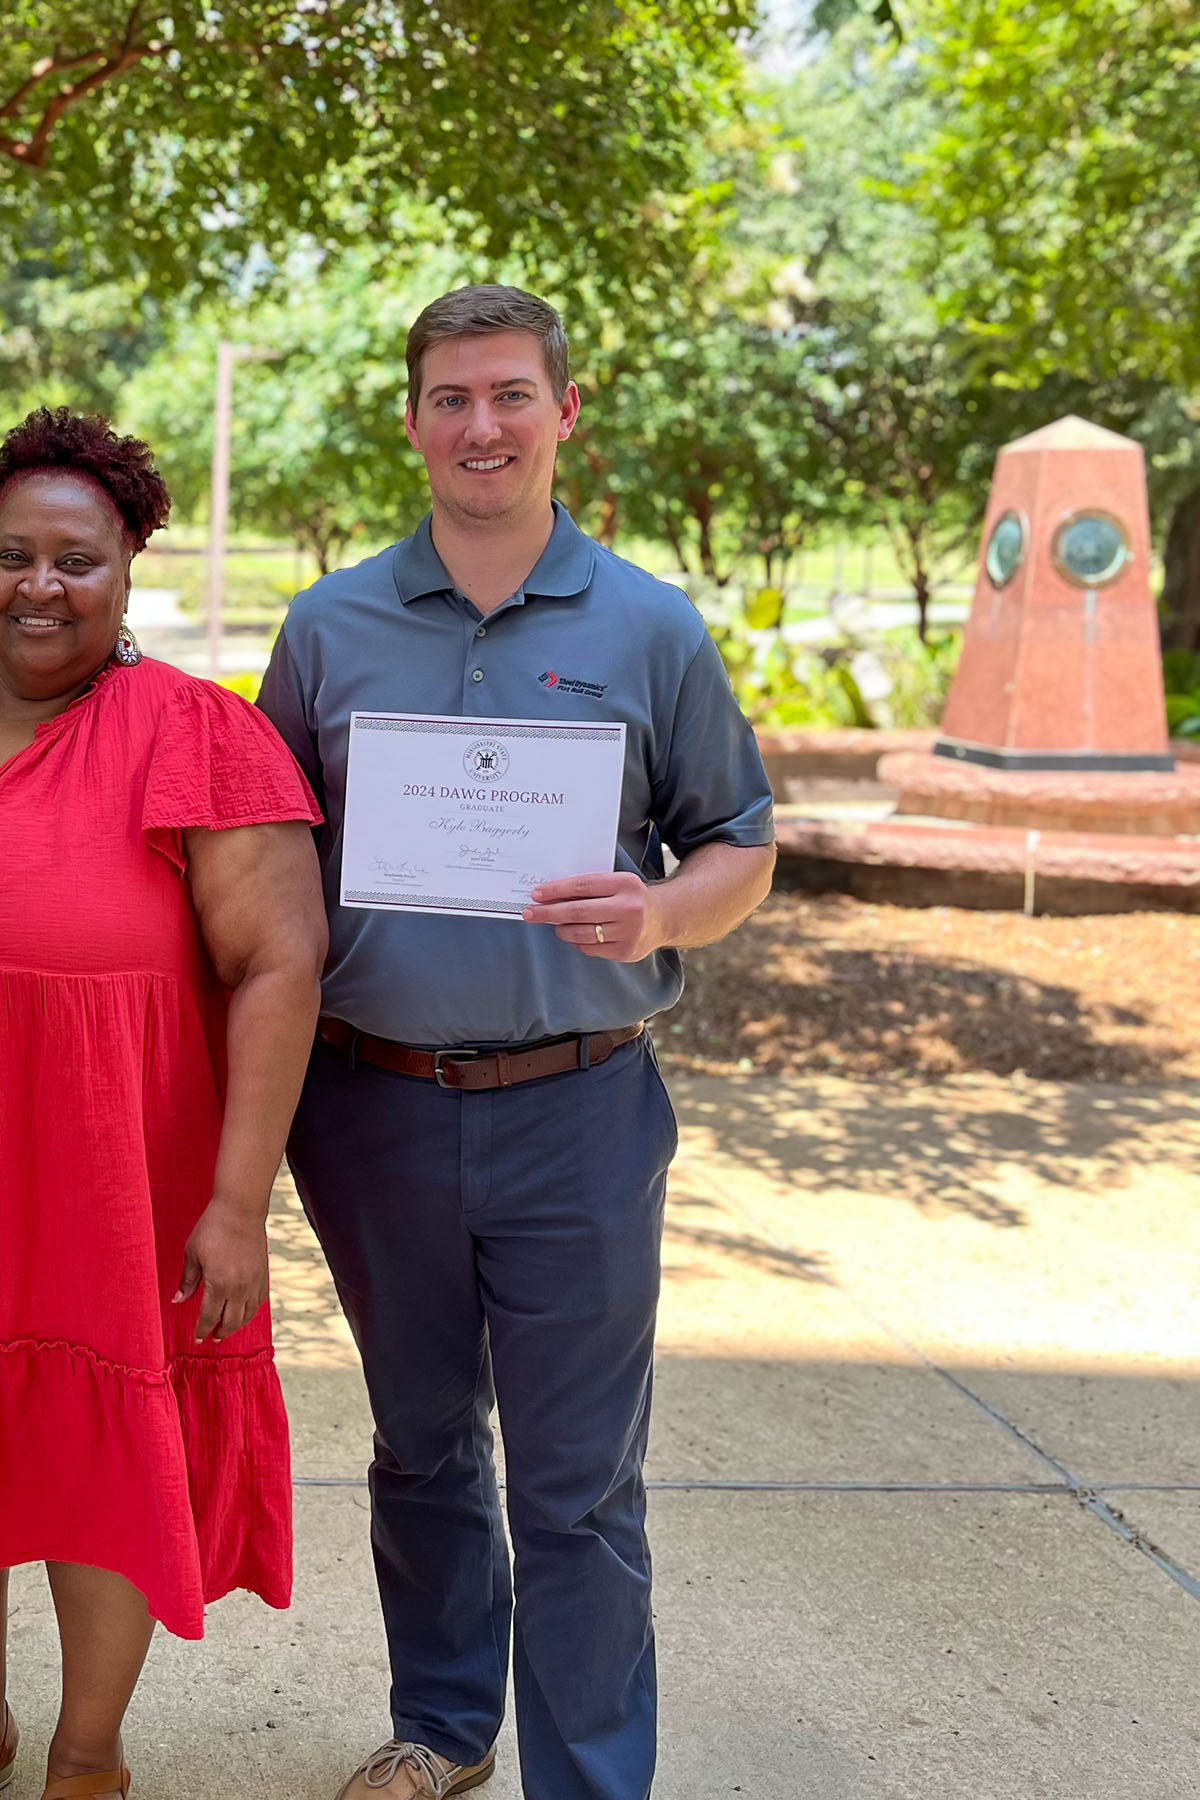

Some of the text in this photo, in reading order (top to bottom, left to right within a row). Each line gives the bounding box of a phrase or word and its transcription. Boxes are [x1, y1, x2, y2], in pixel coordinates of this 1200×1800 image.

[465, 740, 496, 759] MISSISSIPPI
[468, 768, 502, 781] UNIVERSITY
[402, 784, 564, 805] 2024 DAWG PROGRAM
[459, 803, 505, 813] GRADUATE
[428, 816, 530, 838] Kyle Baggerly
